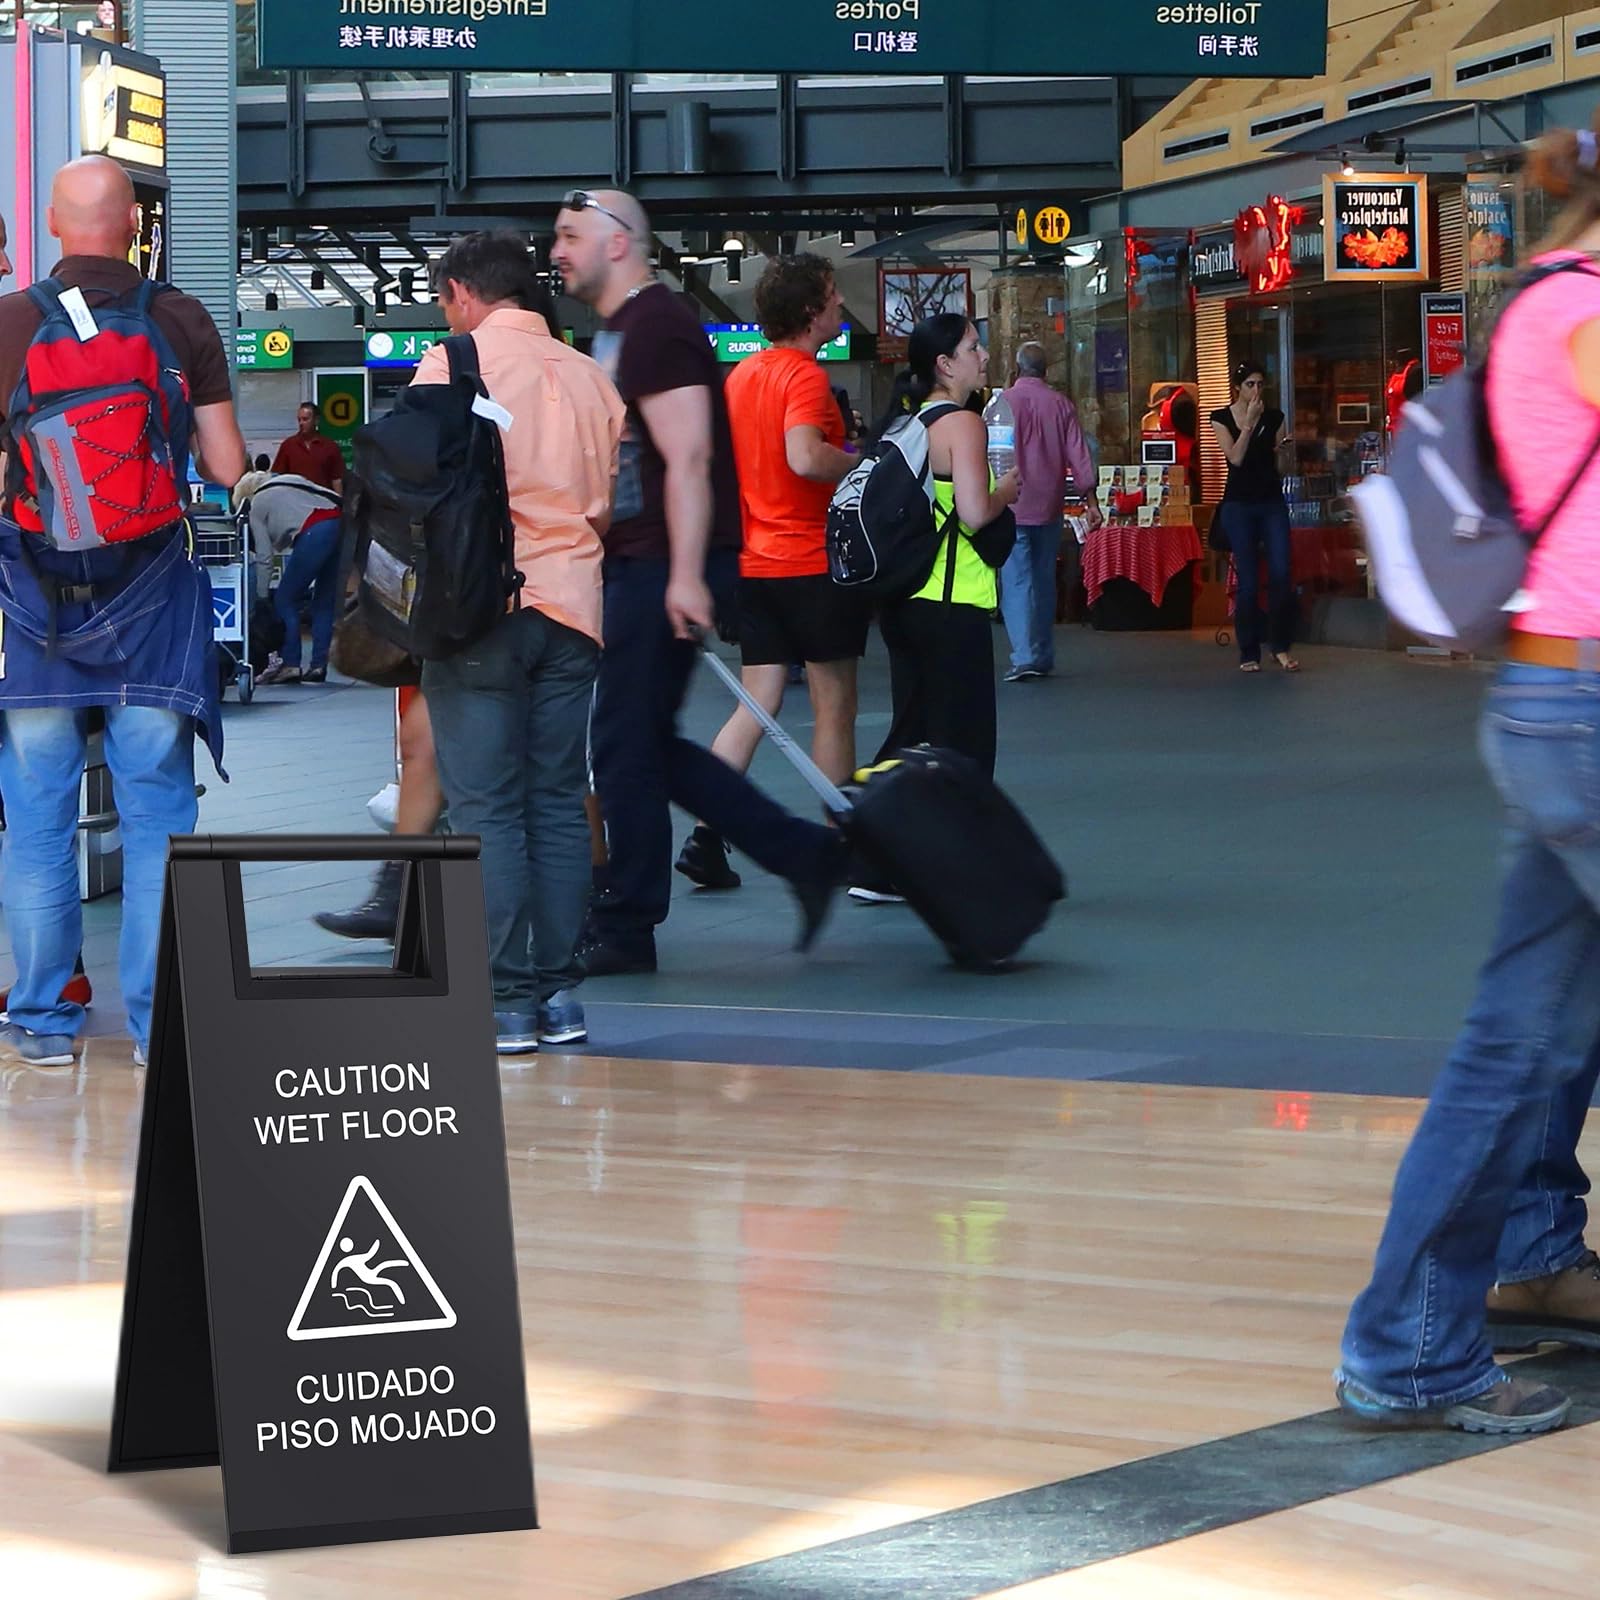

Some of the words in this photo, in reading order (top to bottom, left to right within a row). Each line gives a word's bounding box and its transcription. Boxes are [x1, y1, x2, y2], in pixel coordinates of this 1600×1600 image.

[275, 1061, 430, 1099] CAUTION
[253, 1112, 330, 1145] WET
[341, 1106, 460, 1141] FLOOR
[296, 1365, 455, 1405] CUIDADO
[256, 1417, 339, 1452] PISO
[350, 1405, 496, 1445] MOJADO
